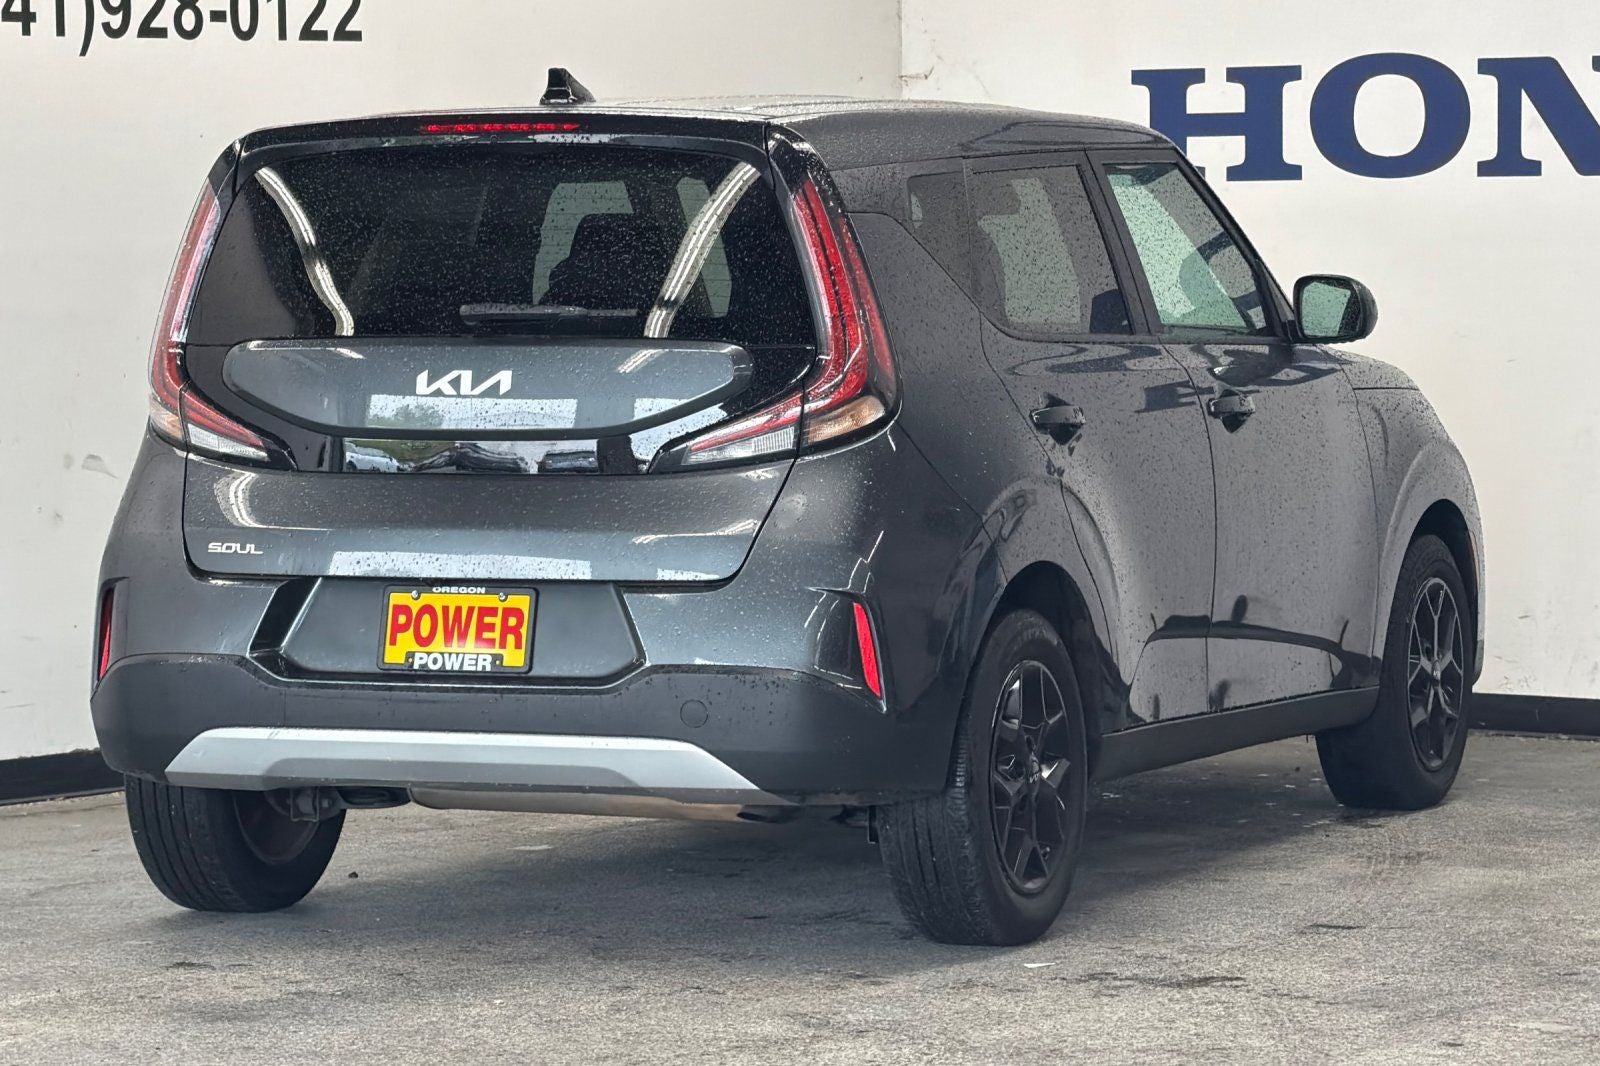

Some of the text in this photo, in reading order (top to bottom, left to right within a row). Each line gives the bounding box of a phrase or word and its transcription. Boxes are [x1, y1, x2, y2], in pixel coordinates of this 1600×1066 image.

[415, 369, 513, 396] KIA
[207, 542, 264, 555] SOUL
[431, 586, 486, 594] OREGON
[389, 603, 525, 650] POWER
[412, 653, 492, 671] POWER
